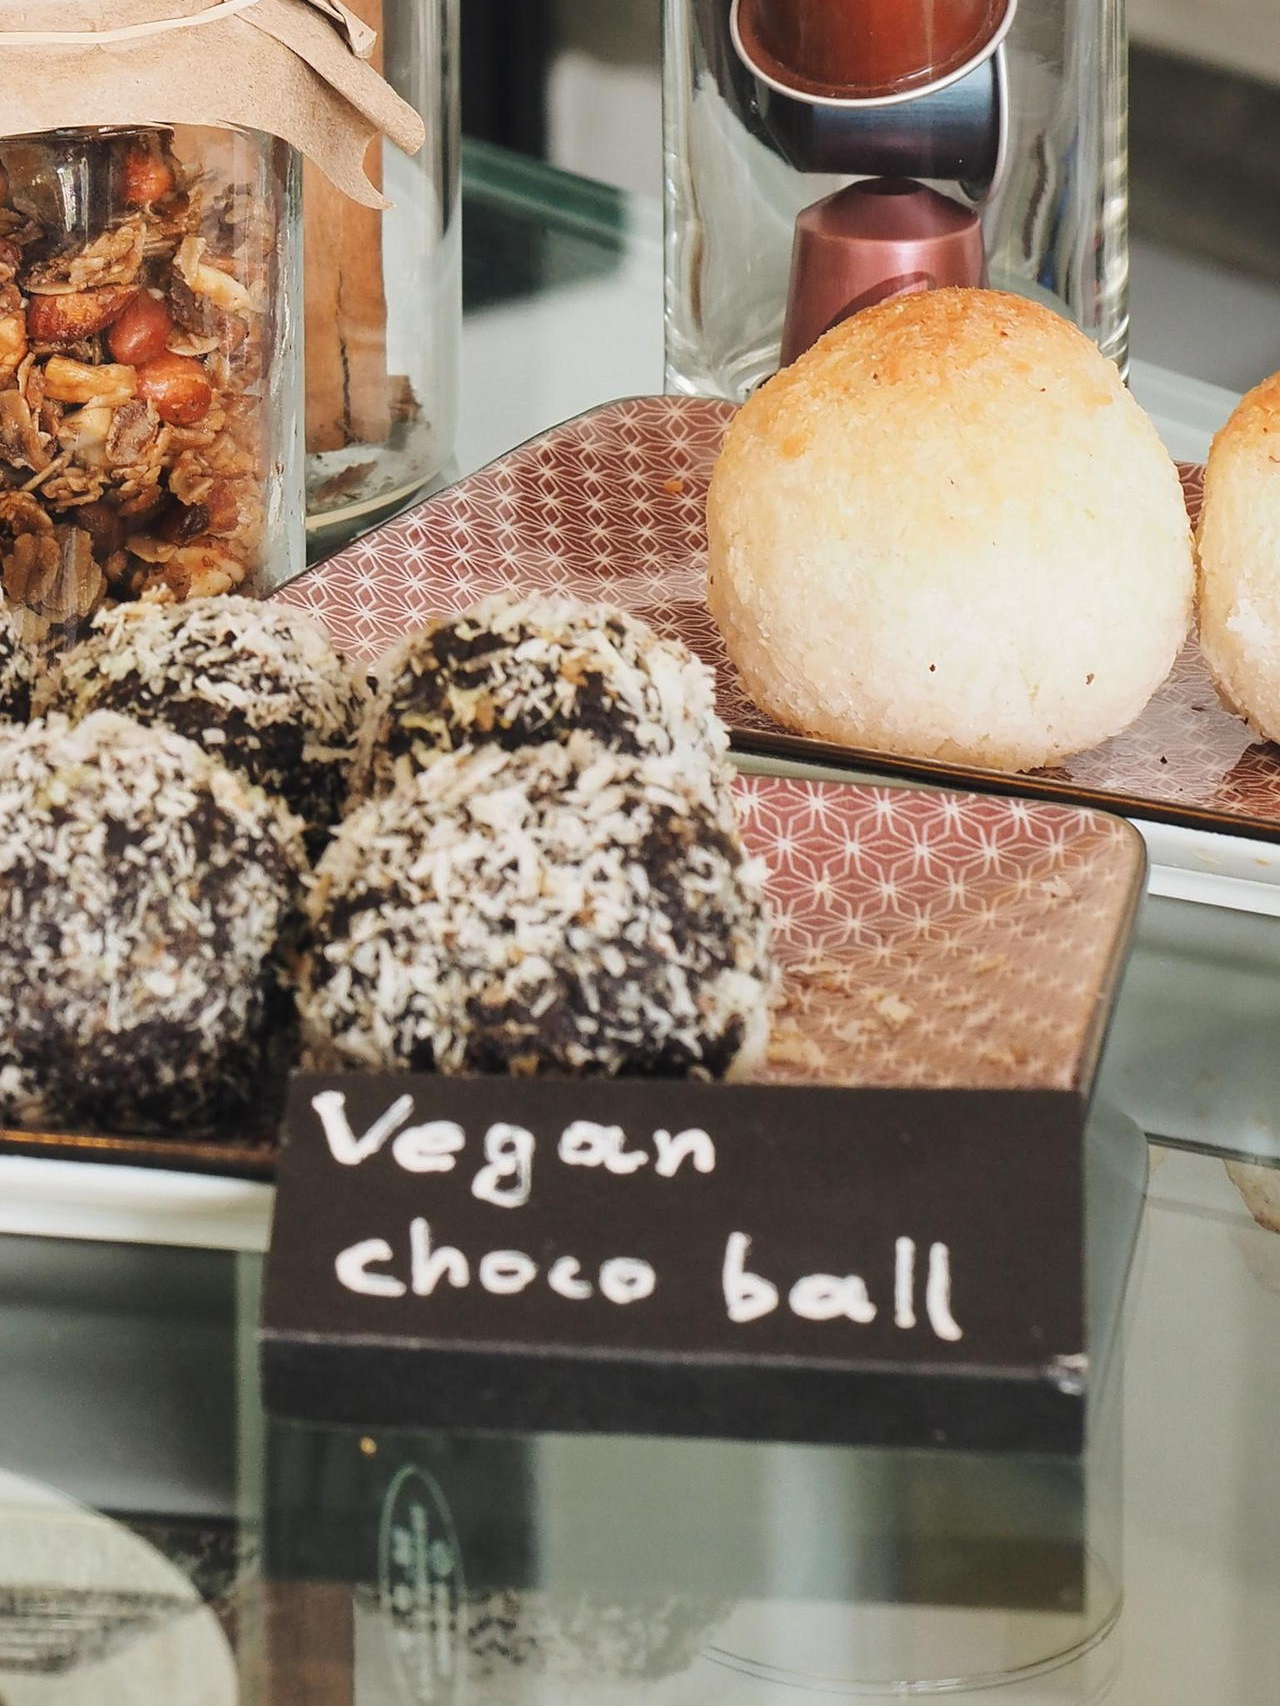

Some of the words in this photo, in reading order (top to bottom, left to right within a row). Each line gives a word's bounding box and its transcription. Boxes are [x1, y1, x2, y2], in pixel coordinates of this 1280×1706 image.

[312, 1090, 716, 1208] Vegan
[335, 1217, 657, 1304] choco
[722, 1231, 963, 1341] ball
